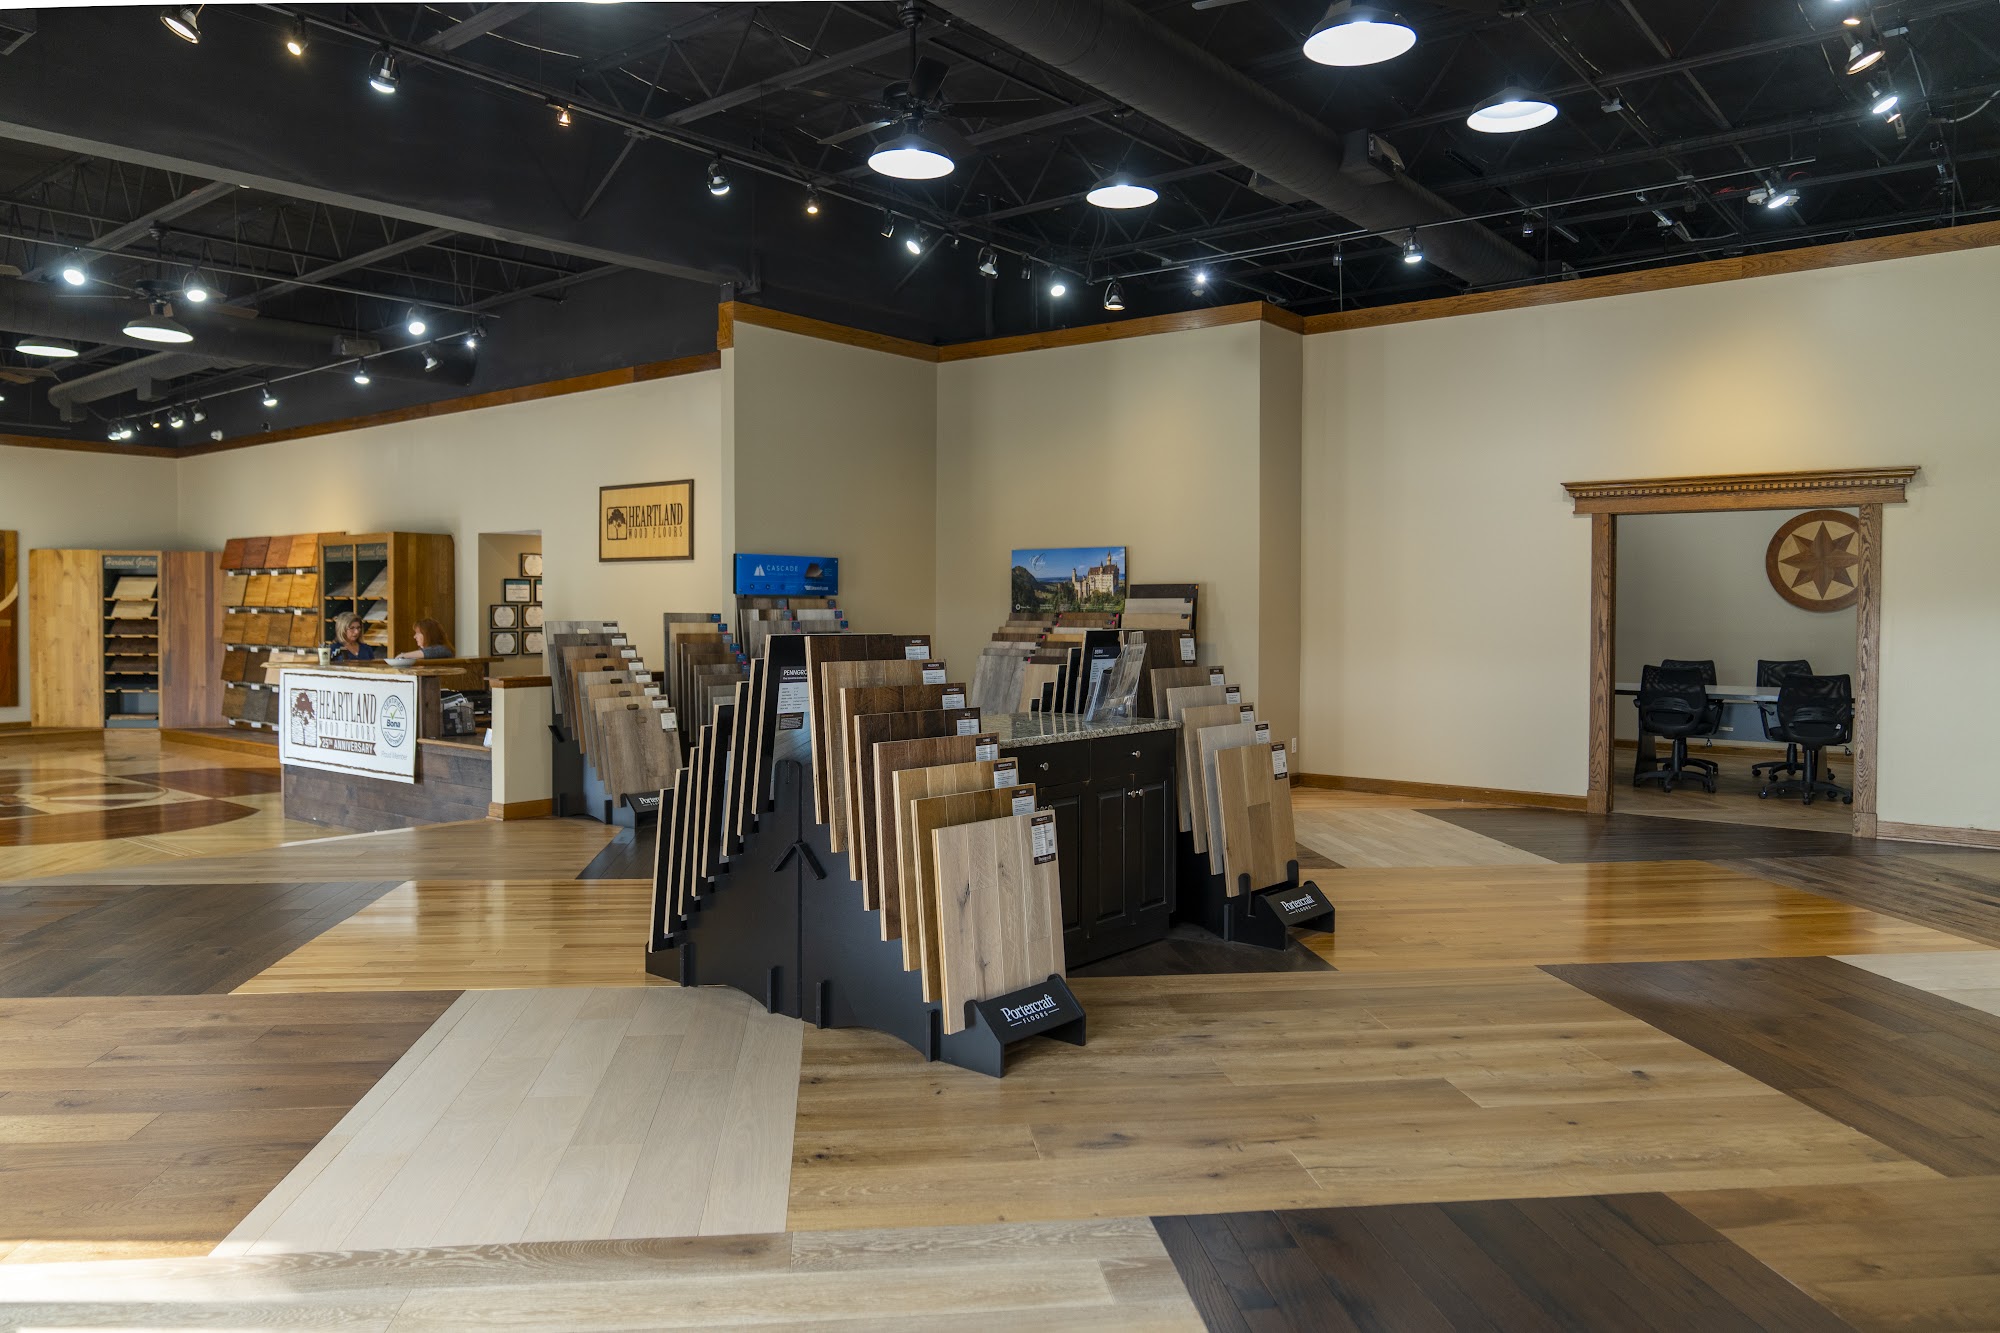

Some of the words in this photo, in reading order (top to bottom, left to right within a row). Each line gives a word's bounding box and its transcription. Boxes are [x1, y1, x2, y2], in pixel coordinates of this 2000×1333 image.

[628, 503, 683, 527] HEARTLAND
[628, 527, 648, 539] WOOD
[652, 526, 683, 539] FLOORS
[766, 564, 799, 572] CASCADE
[318, 689, 377, 725] HEARTLAND
[319, 720, 339, 737] WOOD
[344, 723, 376, 742] FLOORS
[386, 719, 401, 728] Bona
[333, 741, 374, 755] ANNIVERSARY
[1280, 893, 1315, 911] Portercraft
[1000, 993, 1056, 1022] Portercraft
[1022, 1010, 1049, 1024] FLOORS
